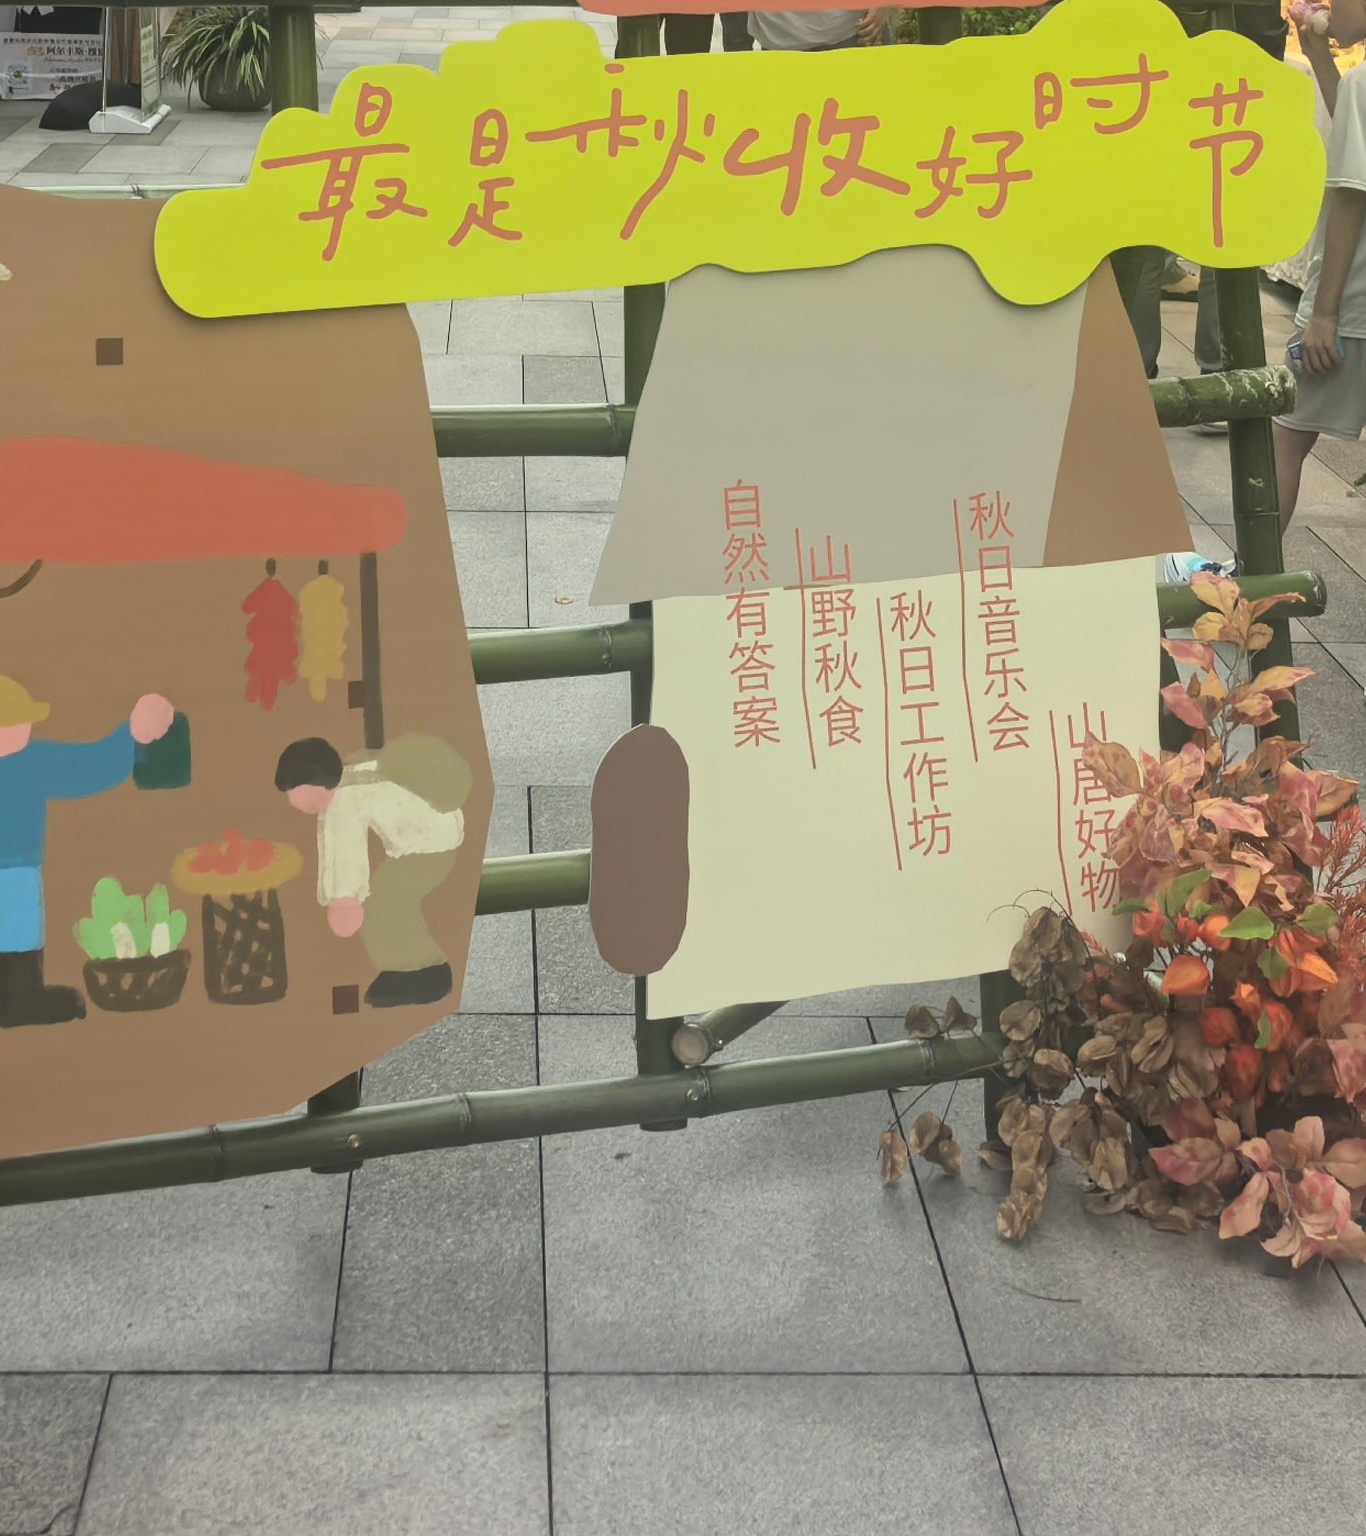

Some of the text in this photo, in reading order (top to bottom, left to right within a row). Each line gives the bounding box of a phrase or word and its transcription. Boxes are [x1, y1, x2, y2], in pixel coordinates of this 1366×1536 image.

[261, 54, 1265, 262] 最是秋收好时节
[722, 479, 782, 750] 自然有答案
[809, 535, 865, 749] 山野秋食
[889, 589, 953, 858] 秋日工作坊
[968, 490, 1031, 753] 秋日音乐会
